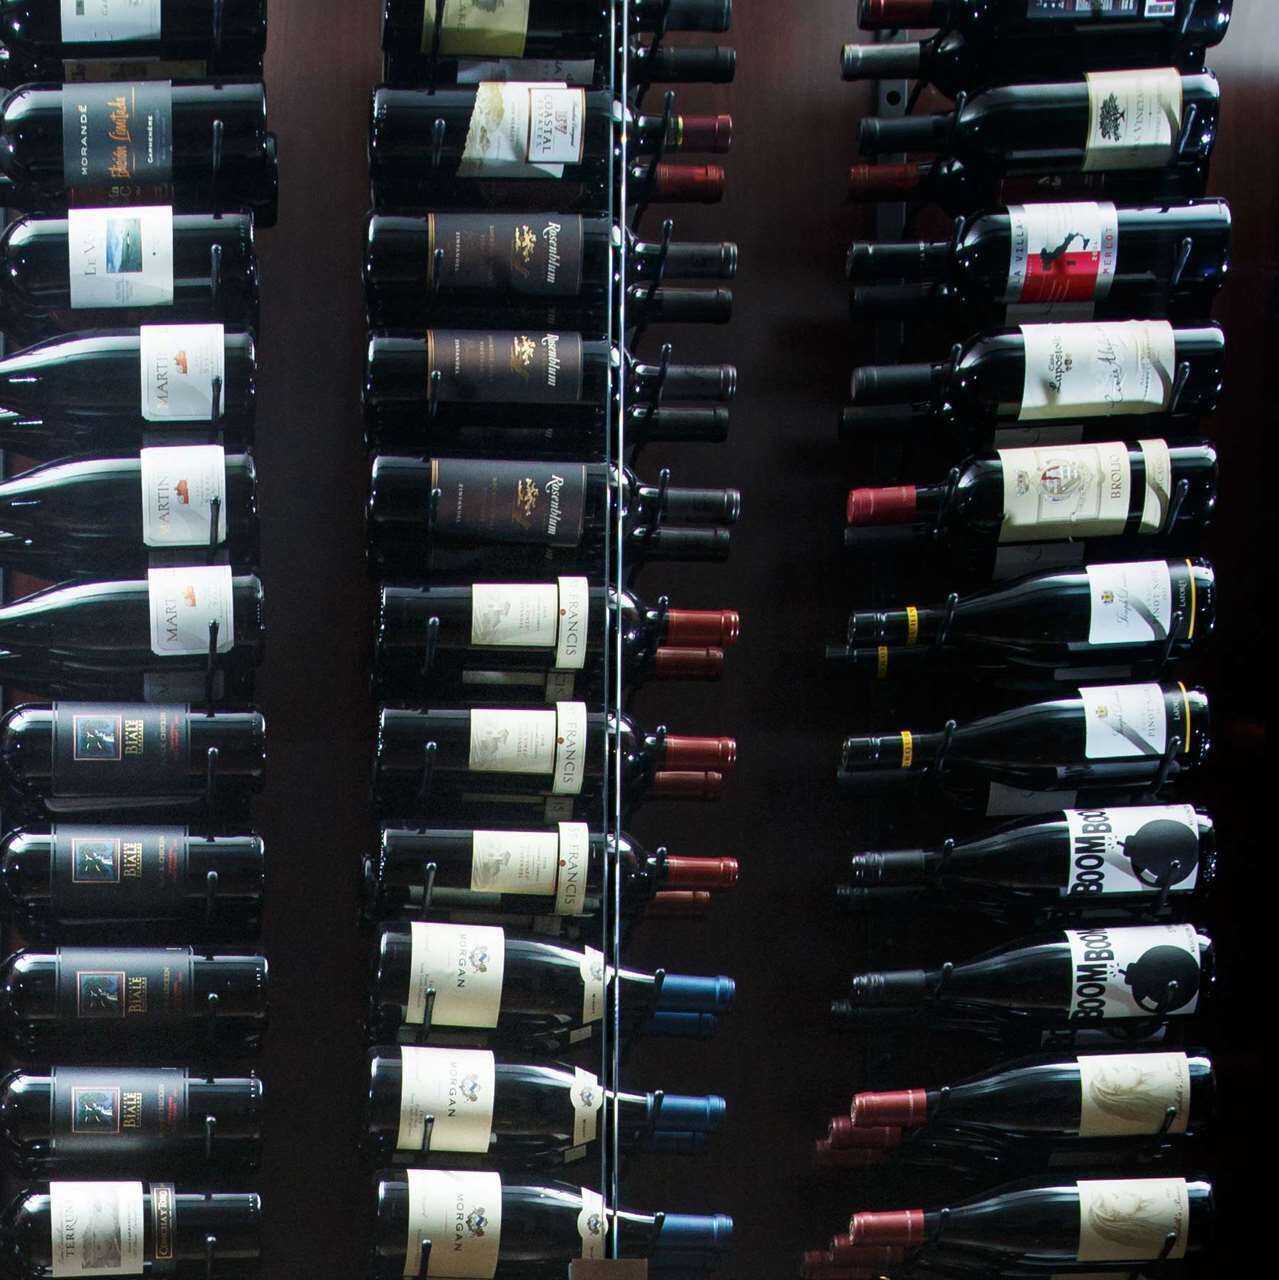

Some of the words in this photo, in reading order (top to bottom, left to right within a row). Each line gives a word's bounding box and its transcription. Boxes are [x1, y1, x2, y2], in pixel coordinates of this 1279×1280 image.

[77, 103, 89, 177] MORANDÉ
[542, 93, 553, 154] COASTAL
[541, 221, 560, 284] Rosenblum
[1102, 225, 1115, 276] MERLOT
[541, 333, 561, 387] Rosenblum
[544, 474, 565, 536] Rosenblum
[565, 593, 580, 656] FRANCIS
[125, 718, 139, 756] BIALE
[563, 721, 579, 786] FRANCIS
[124, 841, 138, 878] BIALE
[563, 842, 580, 906] FRANCIS
[1070, 835, 1106, 897] BOOM
[455, 932, 467, 990] MORGAN
[127, 975, 142, 1014] BIALE
[1070, 963, 1110, 1022] BOOM
[123, 1091, 137, 1129] BIALE
[447, 1060, 458, 1118] MORGAN
[452, 1192, 465, 1252] MORGAN
